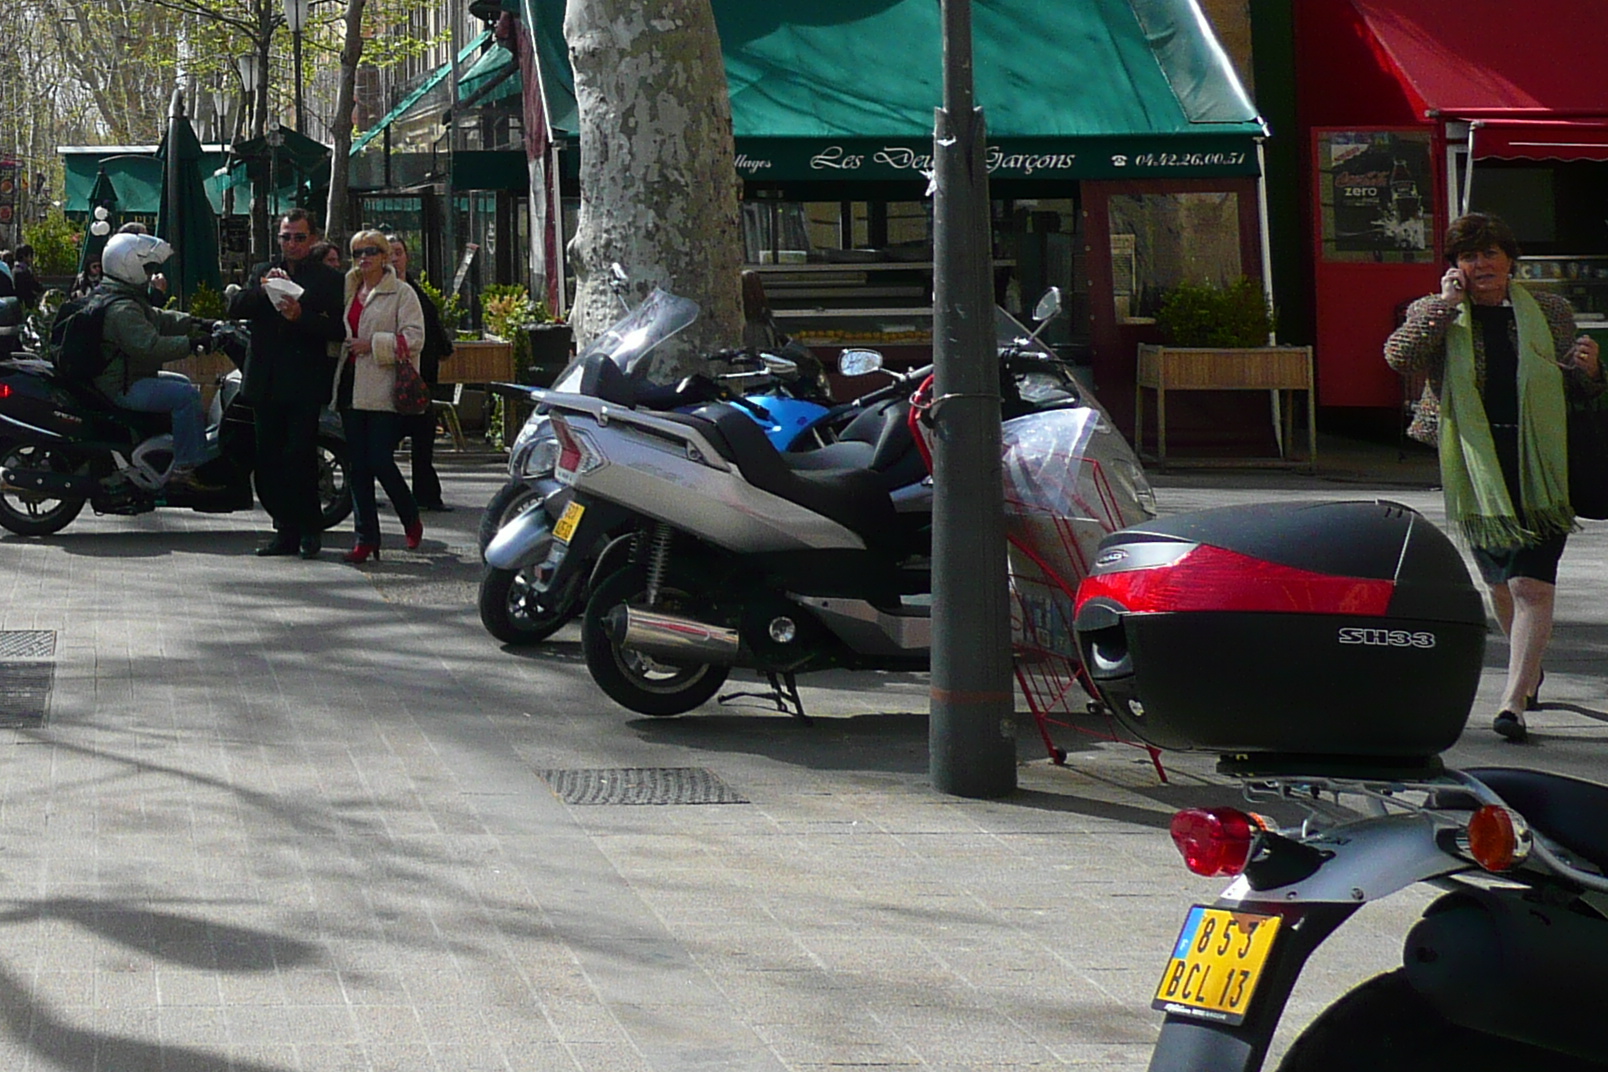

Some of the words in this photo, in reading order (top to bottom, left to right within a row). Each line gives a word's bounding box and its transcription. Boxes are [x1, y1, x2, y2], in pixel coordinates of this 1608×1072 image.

[809, 146, 864, 170] Les
[873, 145, 936, 169] Deu
[1135, 152, 1246, 167] 04.42.26.00.51
[1343, 187, 1378, 197] zero
[1338, 627, 1436, 649] SH33
[1197, 917, 1260, 959] 853
[1166, 960, 1211, 1003] BCL
[1218, 968, 1250, 1008] 13
